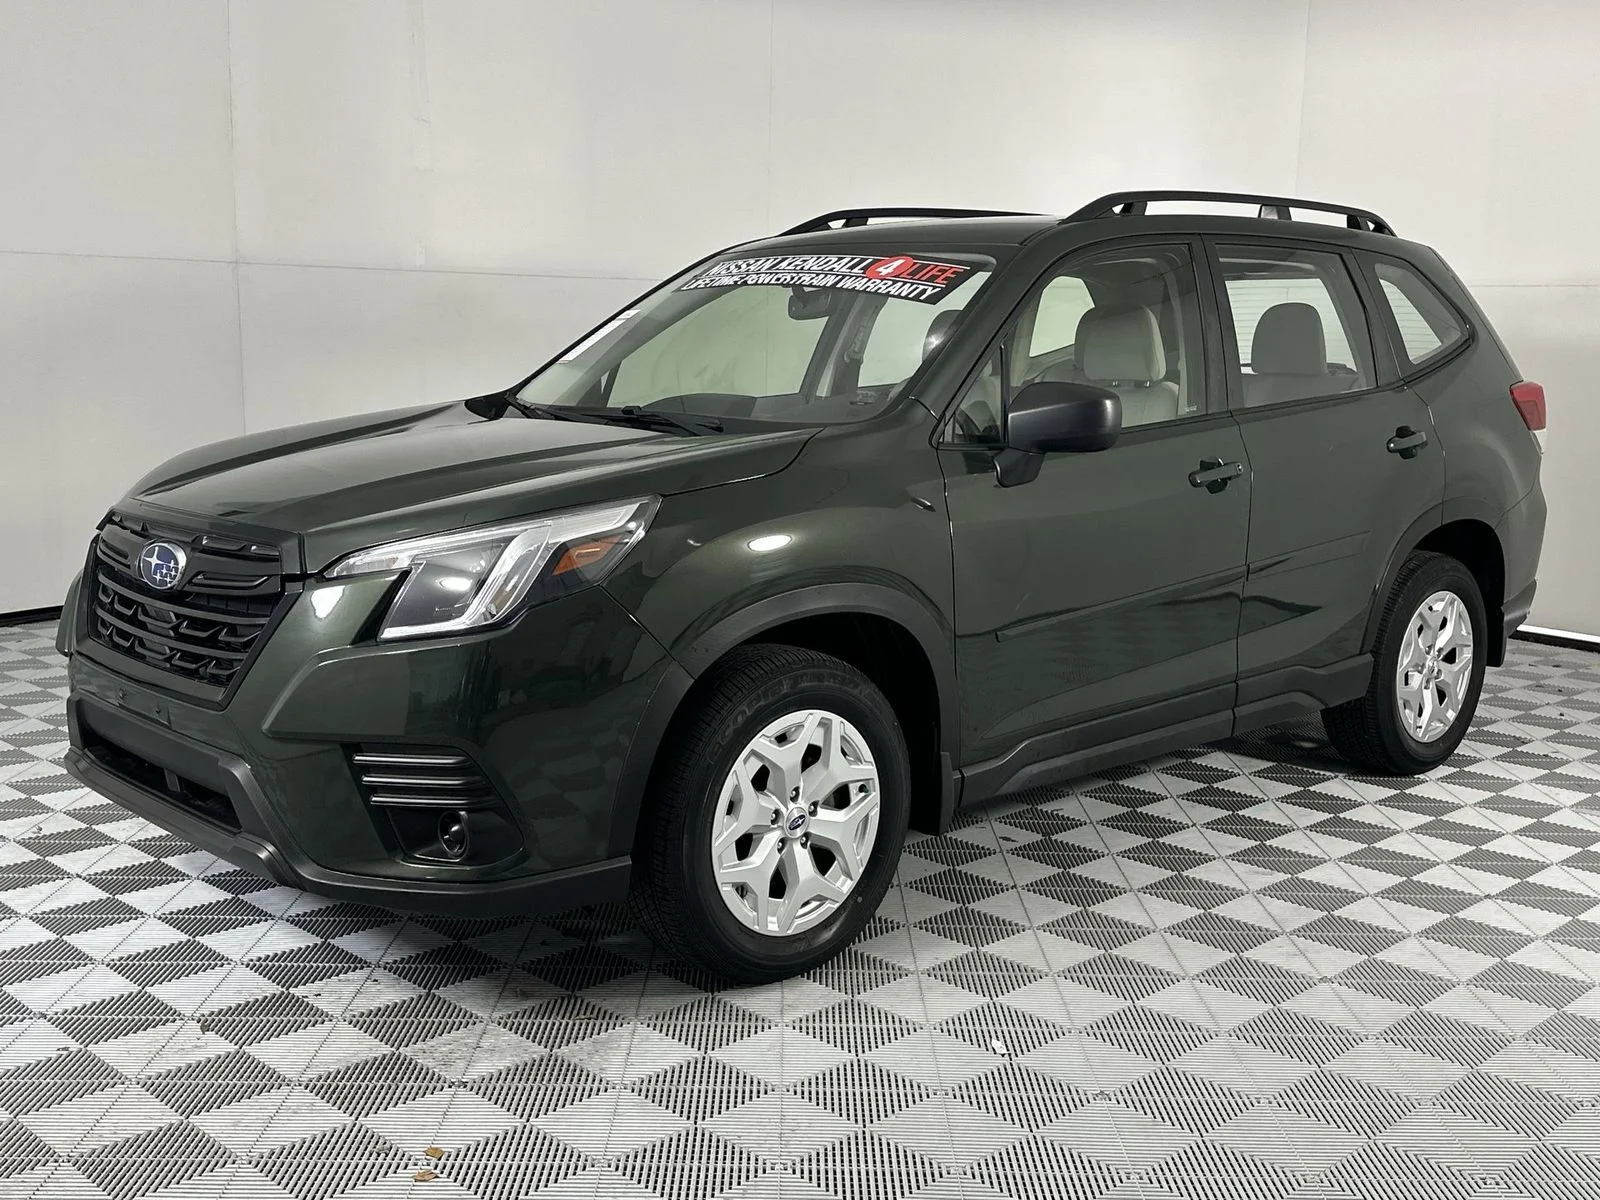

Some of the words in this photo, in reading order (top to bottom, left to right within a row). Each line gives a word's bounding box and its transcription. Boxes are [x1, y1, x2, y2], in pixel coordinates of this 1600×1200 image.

[702, 258, 779, 277] NISSAN
[773, 256, 873, 274] KENDALL
[874, 259, 906, 276] 4
[899, 263, 965, 284] LIFE
[681, 274, 747, 290] LIFETIME
[737, 273, 843, 287] POWERTRAIN
[836, 274, 942, 300] WARRANTY
